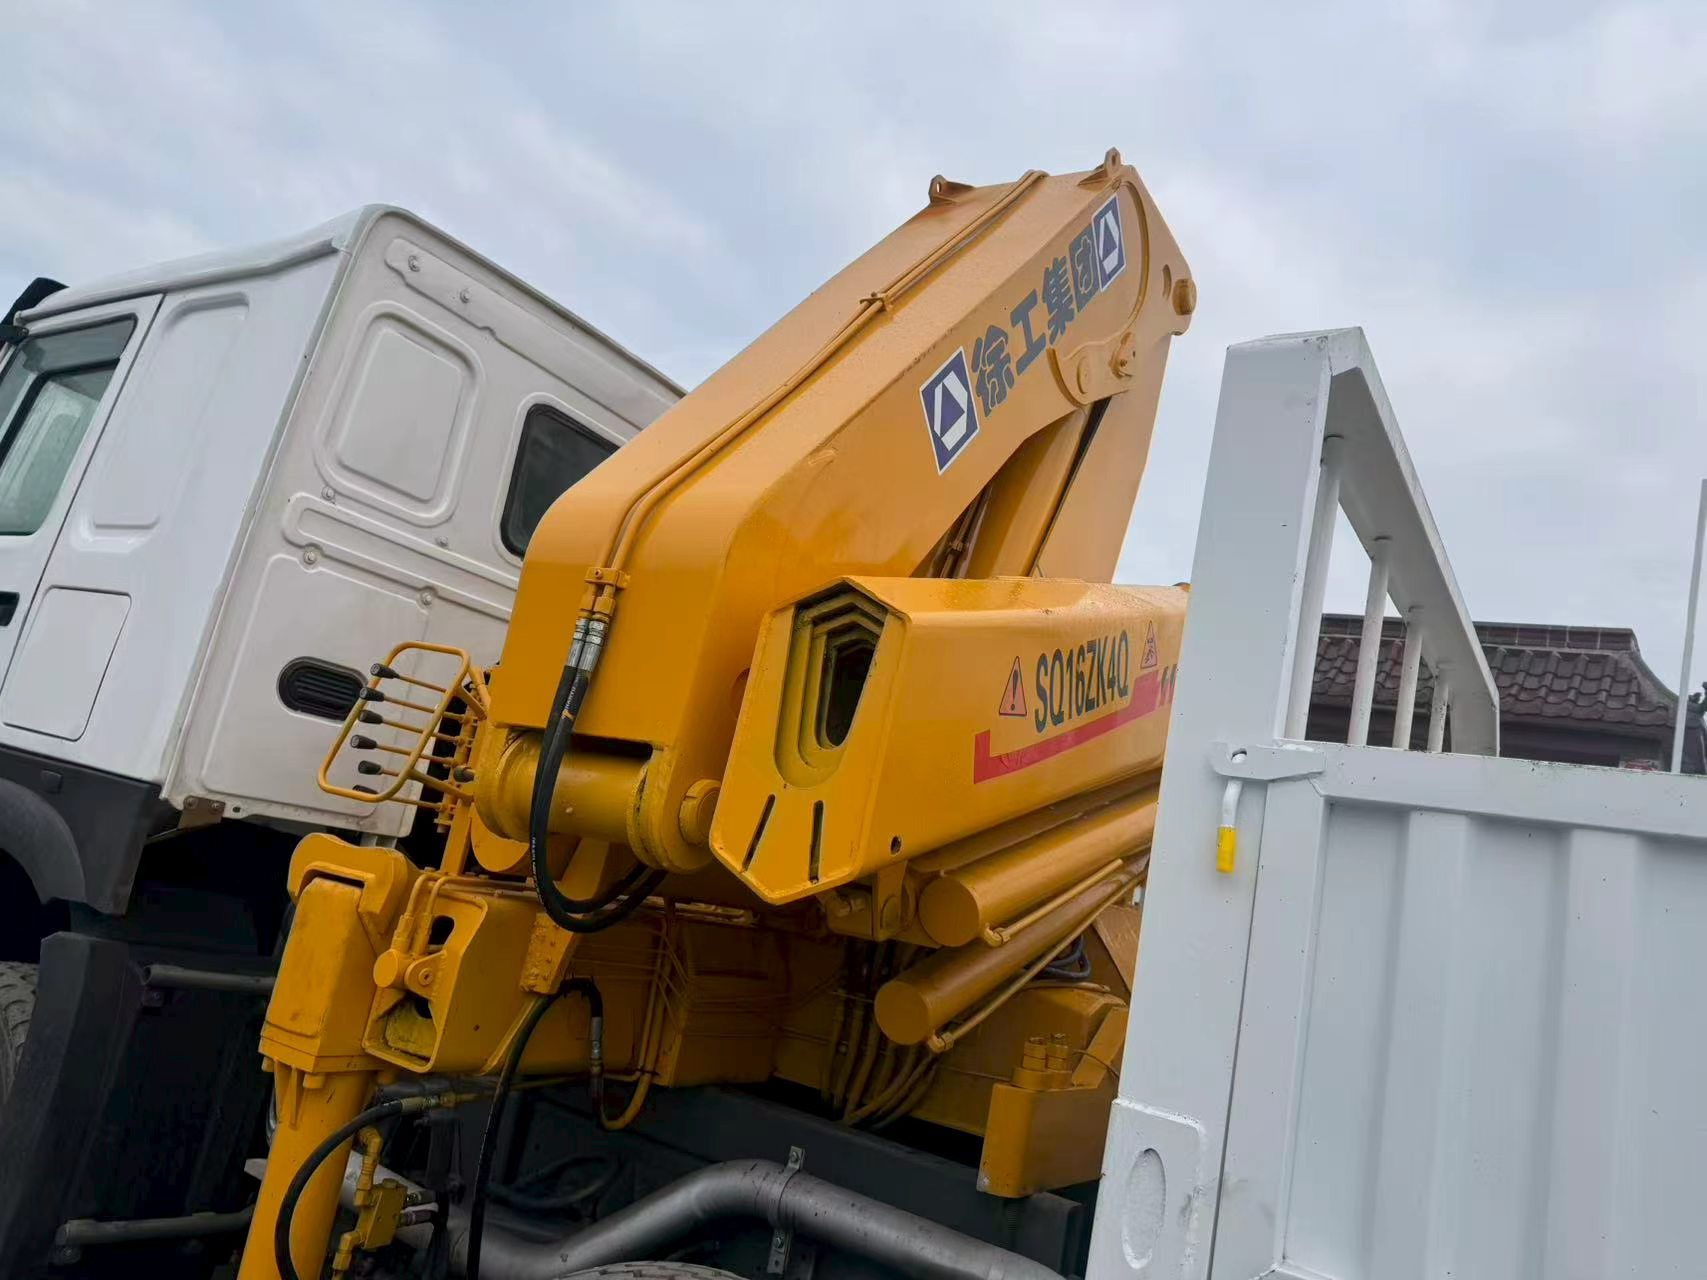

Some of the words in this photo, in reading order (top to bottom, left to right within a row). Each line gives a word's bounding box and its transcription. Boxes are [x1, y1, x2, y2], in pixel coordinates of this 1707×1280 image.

[971, 223, 1101, 417] 徐工集团
[1034, 629, 1128, 734] SQ16ZK4Q
